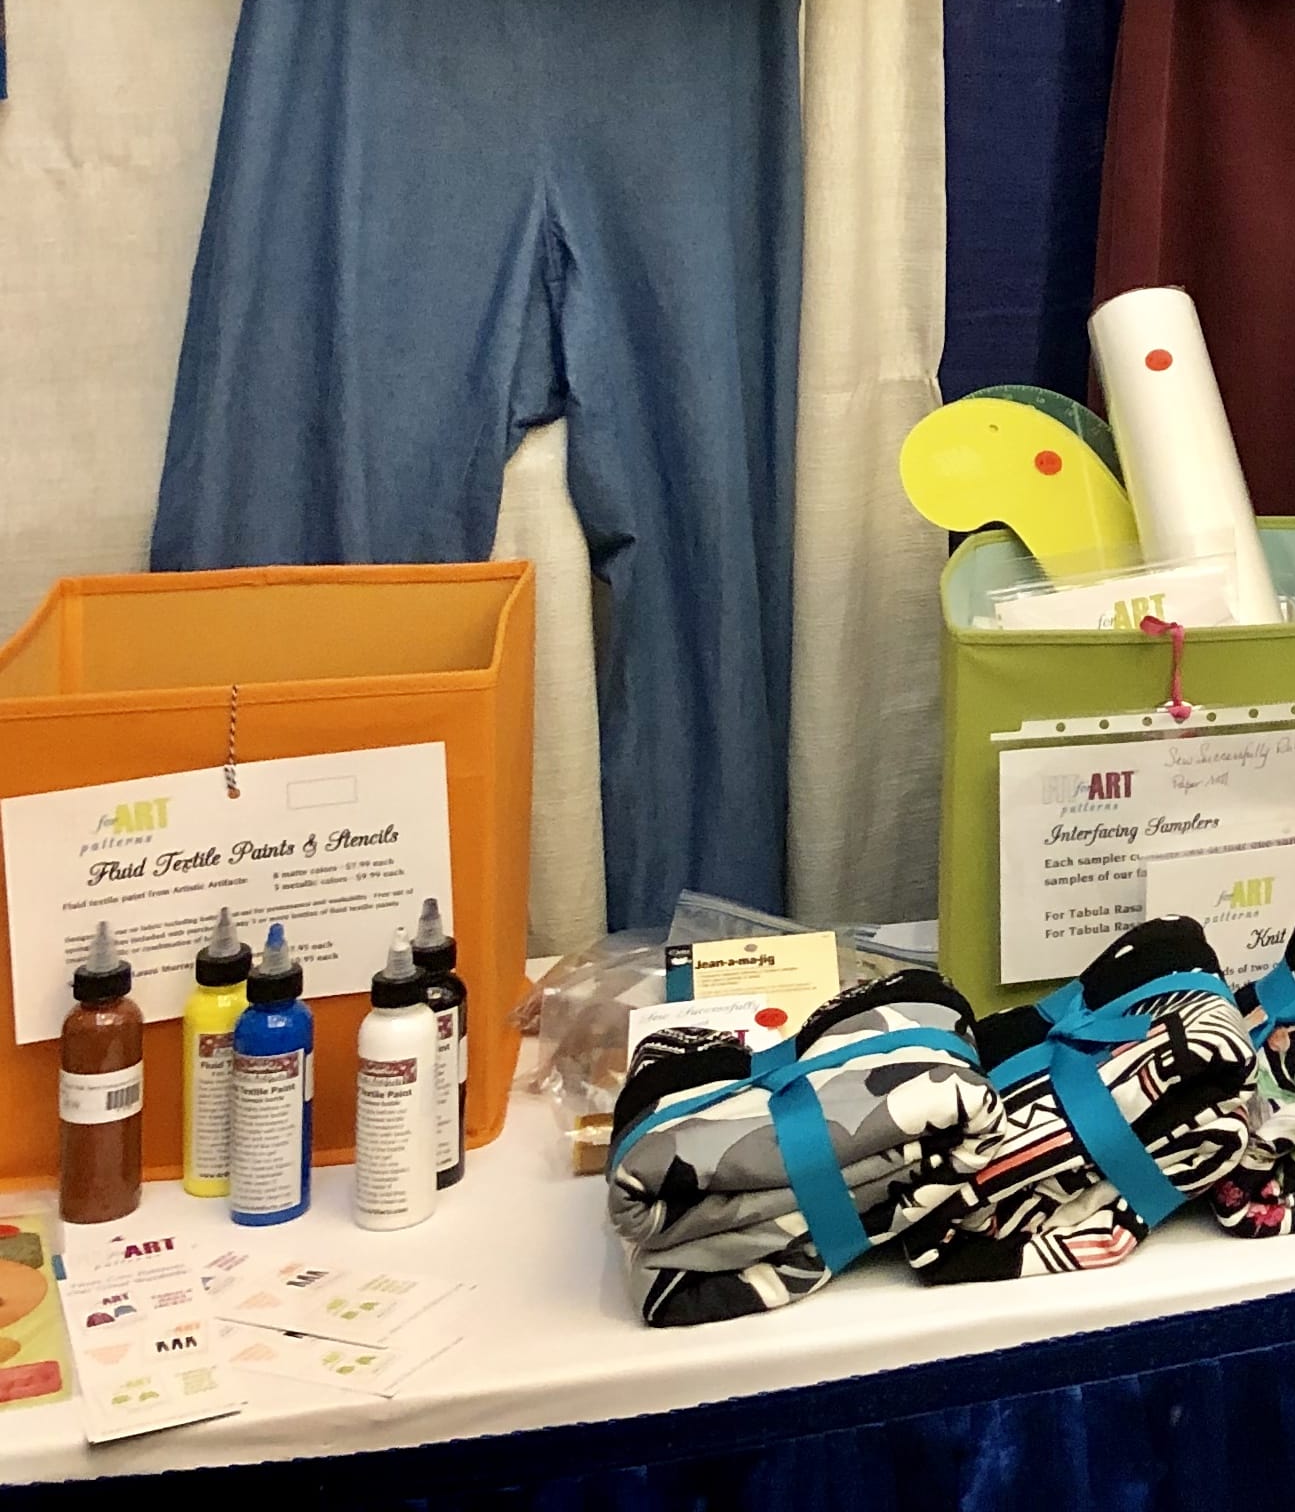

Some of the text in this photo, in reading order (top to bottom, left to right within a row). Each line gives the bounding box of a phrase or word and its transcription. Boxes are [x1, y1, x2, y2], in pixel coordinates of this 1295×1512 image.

[1089, 770, 1135, 800] ART
[114, 798, 170, 834] ART
[1060, 802, 1118, 815] patterns
[1044, 813, 1220, 846] Interfacing Samplers
[79, 835, 152, 856] patterns
[87, 824, 399, 887] Fluid Textile Paints & Stencils
[1044, 853, 1126, 869] Each sampler
[1044, 873, 1094, 886] samples
[1098, 870, 1109, 881] of
[1113, 871, 1133, 881] our
[1230, 877, 1275, 909] ART
[1045, 903, 1143, 922] For Tabula Rasa
[1204, 910, 1259, 928] patterns
[1045, 928, 1065, 939] For
[1069, 924, 1110, 937] Tabula
[1247, 928, 1287, 949] Knit
[695, 954, 775, 970] Jean-a-ma-jig
[1238, 963, 1247, 974] of
[1250, 962, 1271, 973] two
[271, 1083, 296, 1094] Paint
[387, 1089, 412, 1098] Paint
[124, 1237, 175, 1258] ART
[102, 1292, 130, 1306] ART
